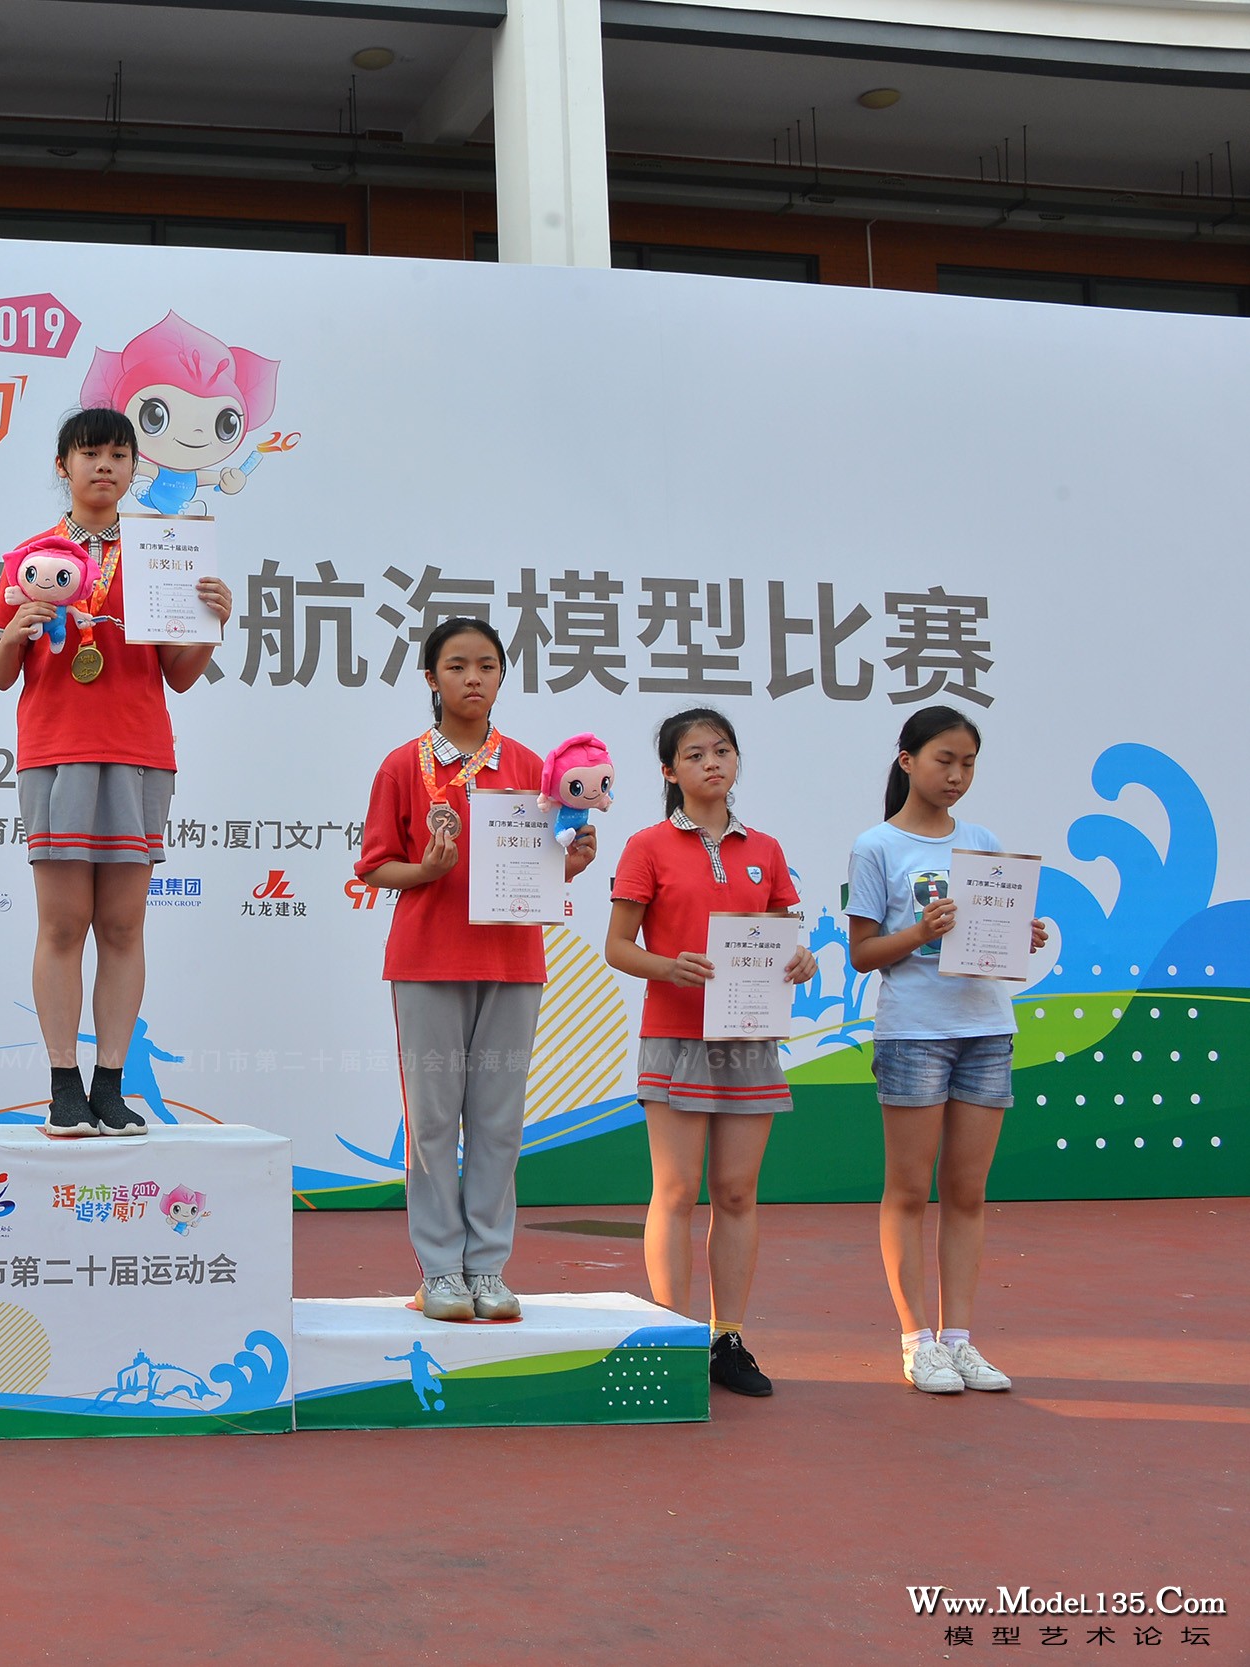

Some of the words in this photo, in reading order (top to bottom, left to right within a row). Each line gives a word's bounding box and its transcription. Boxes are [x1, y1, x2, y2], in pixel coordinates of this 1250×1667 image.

[240, 901, 308, 917] 九龙建设
[52, 1183, 130, 1212] 活力市运
[134, 1183, 156, 1195] 2019
[75, 1201, 148, 1223] 追梦厦门
